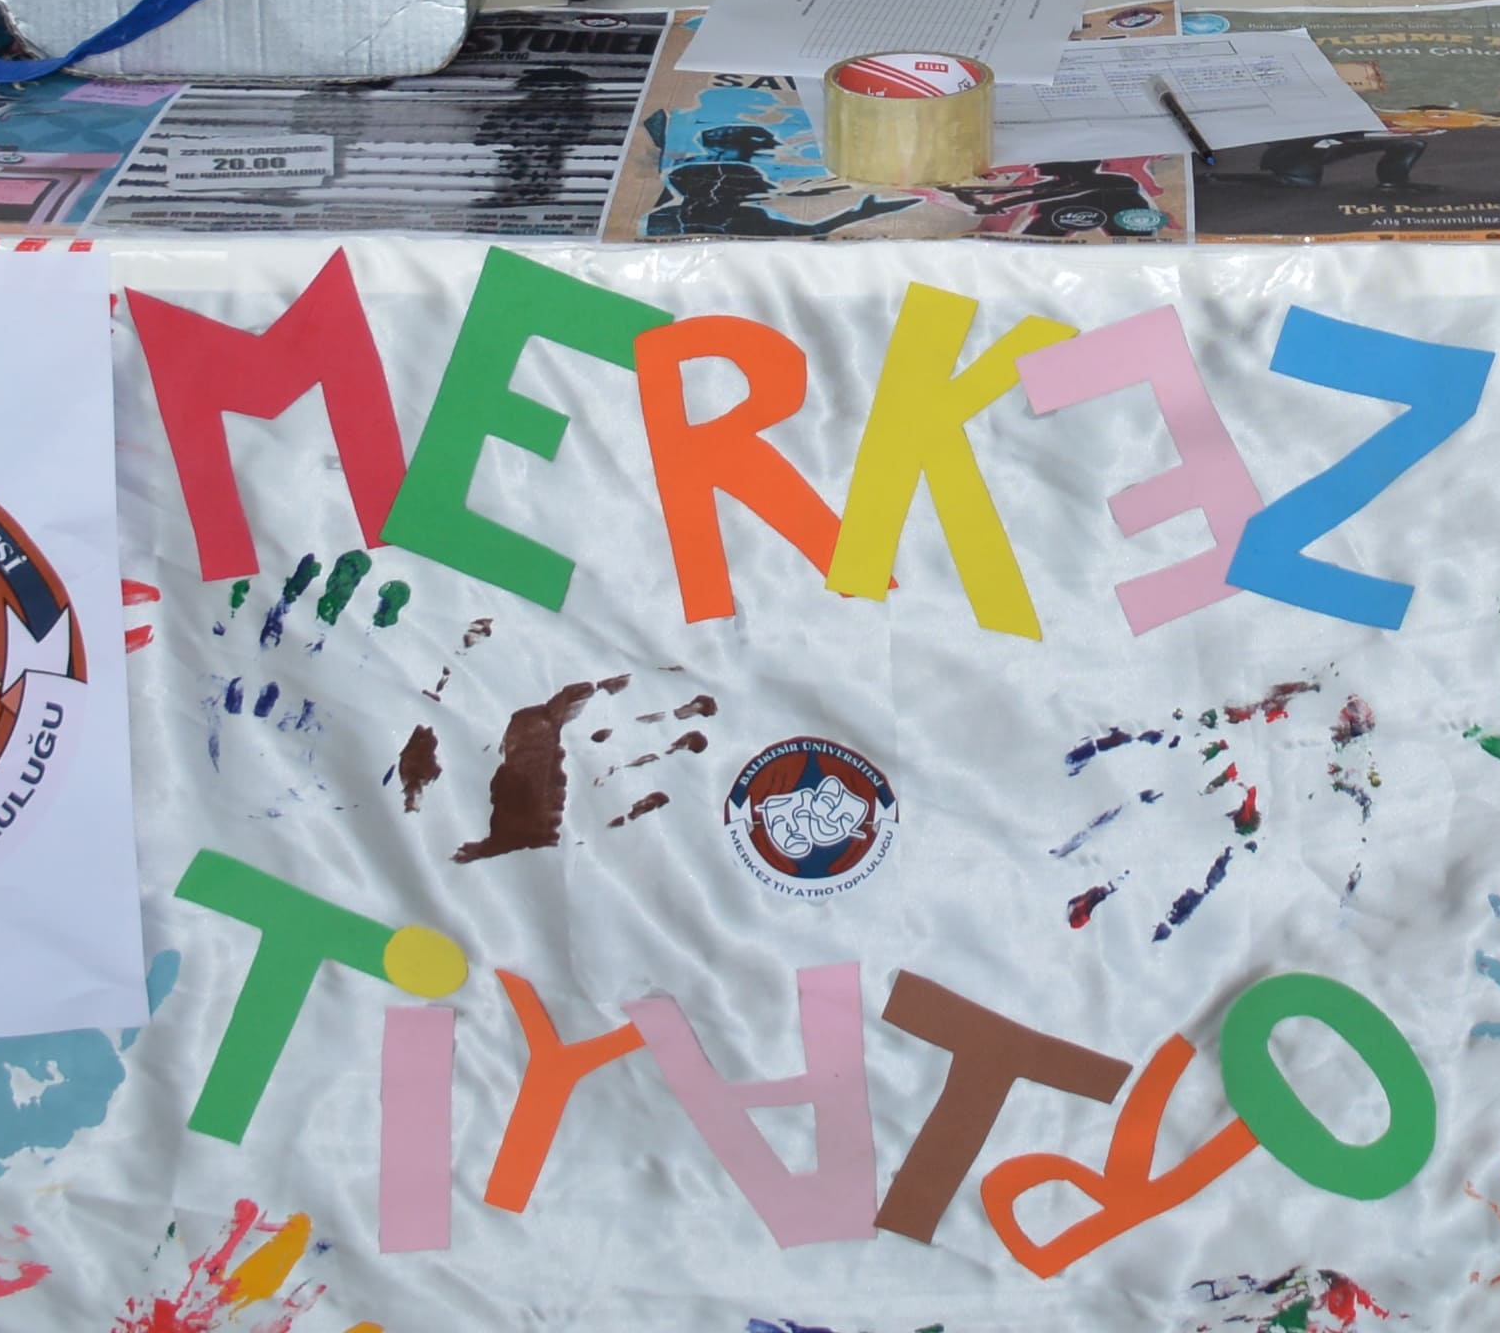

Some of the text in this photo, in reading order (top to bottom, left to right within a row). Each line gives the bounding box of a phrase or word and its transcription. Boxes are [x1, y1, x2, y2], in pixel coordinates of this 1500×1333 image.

[1336, 46, 1421, 56] Anton
[212, 156, 288, 172] 20.00
[1338, 204, 1387, 217] Tek
[124, 245, 1496, 642] MERKEZ
[739, 740, 885, 788] BALIKESİR ÜNİVERSİTESİ
[729, 829, 835, 898] MERKEZ TİYATRO
[172, 847, 1438, 1280] TİYATRO
